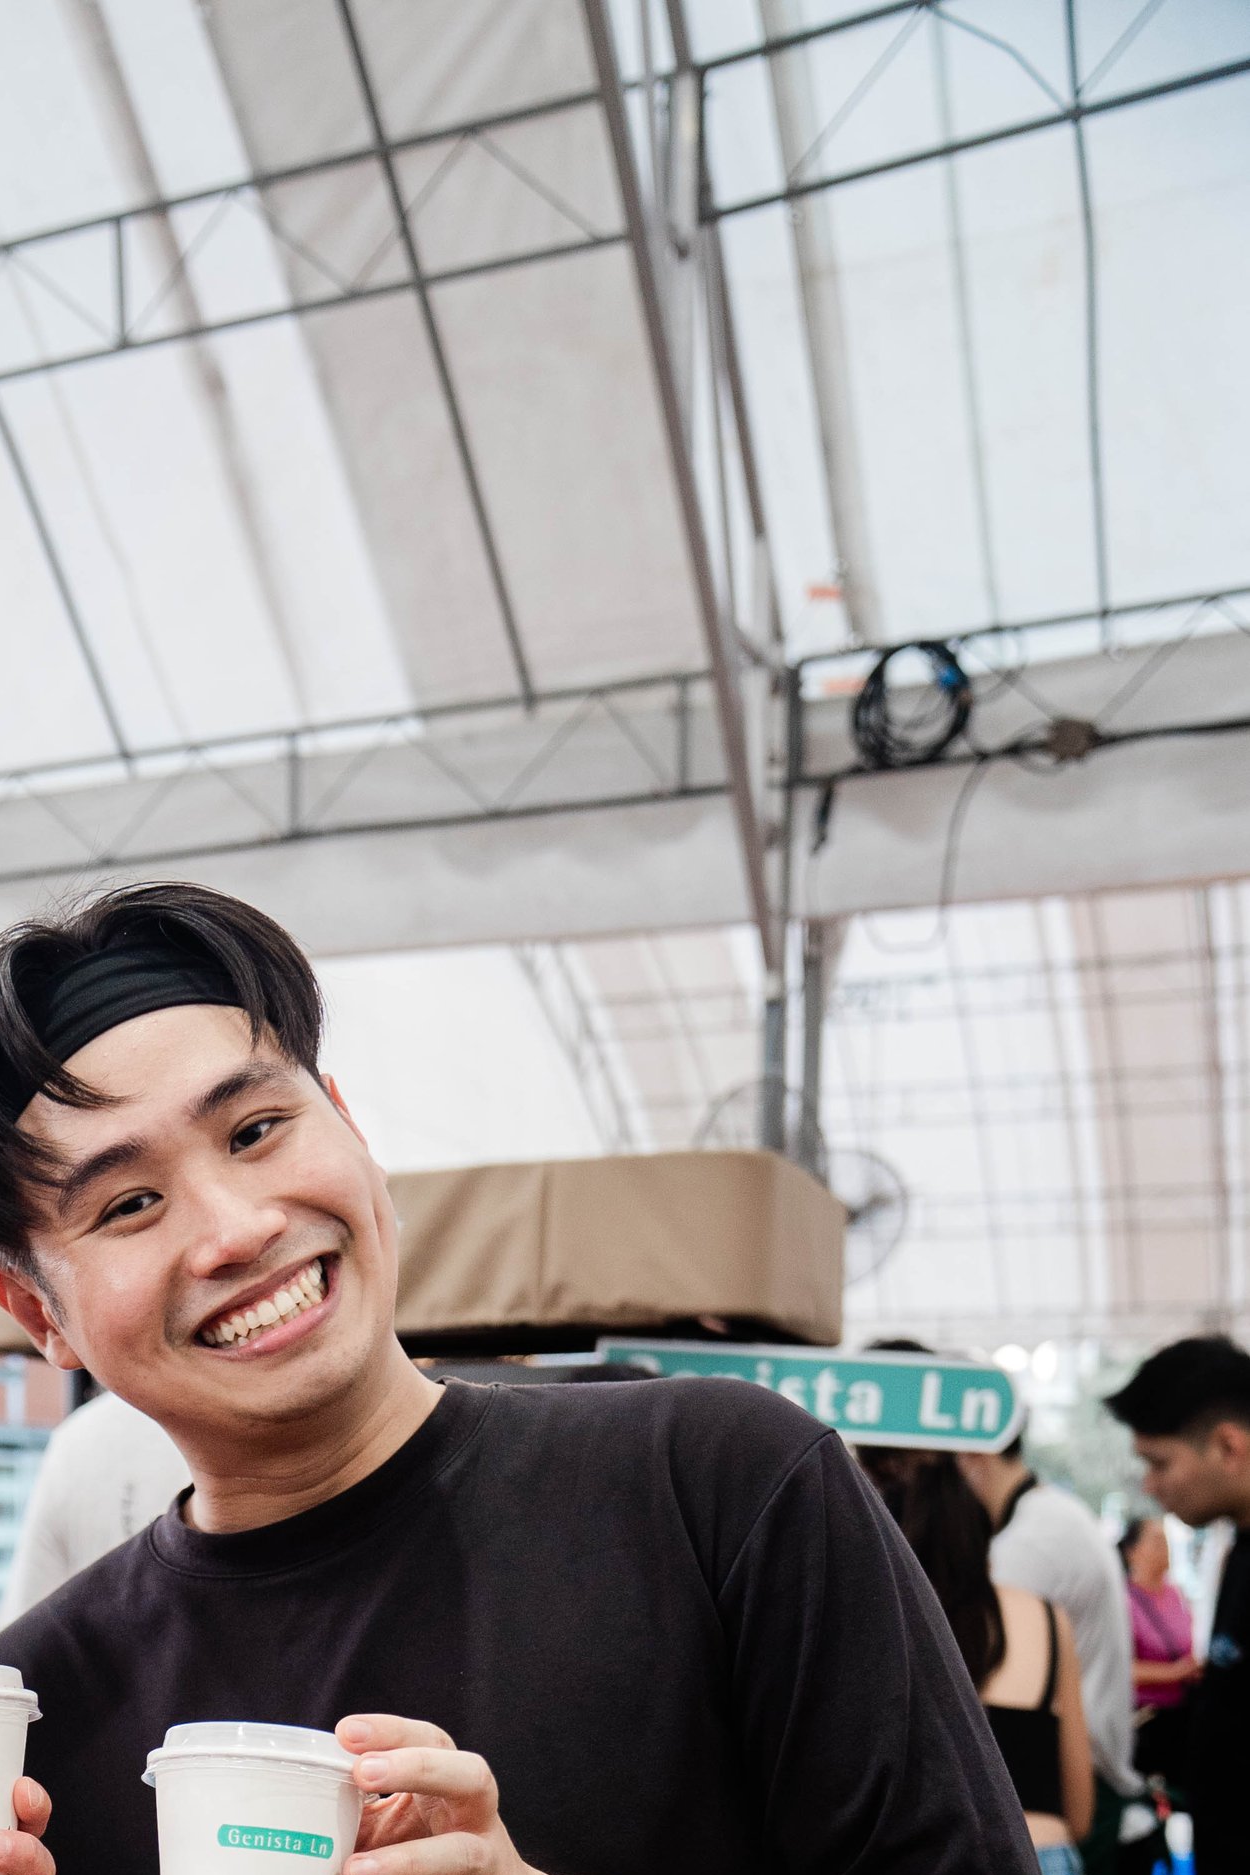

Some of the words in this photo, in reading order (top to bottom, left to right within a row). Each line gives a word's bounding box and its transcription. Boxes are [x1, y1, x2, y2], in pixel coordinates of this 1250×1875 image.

[919, 1371, 1000, 1432] Ln
[228, 1829, 301, 1850] Genista
[310, 1839, 327, 1855] Ln
